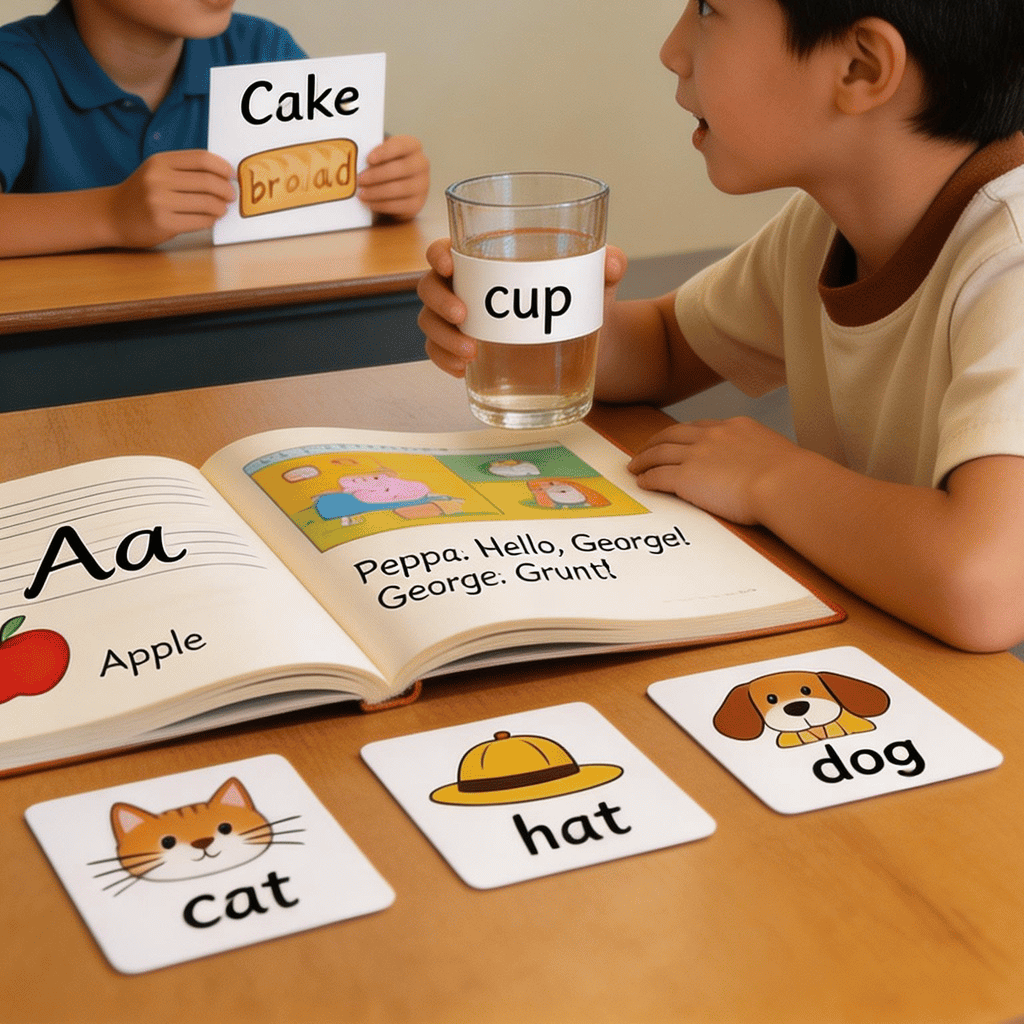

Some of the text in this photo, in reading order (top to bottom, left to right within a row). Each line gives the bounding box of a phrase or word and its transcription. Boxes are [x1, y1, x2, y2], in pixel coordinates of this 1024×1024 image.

[240, 73, 359, 126] Cake
[484, 285, 572, 335] cup
[23, 525, 187, 600] Aa
[474, 533, 564, 558] Hello,
[571, 526, 691, 555] George!
[99, 629, 207, 678] Apple
[812, 739, 926, 784] dog
[512, 801, 632, 856] hat
[183, 871, 299, 929] cat
